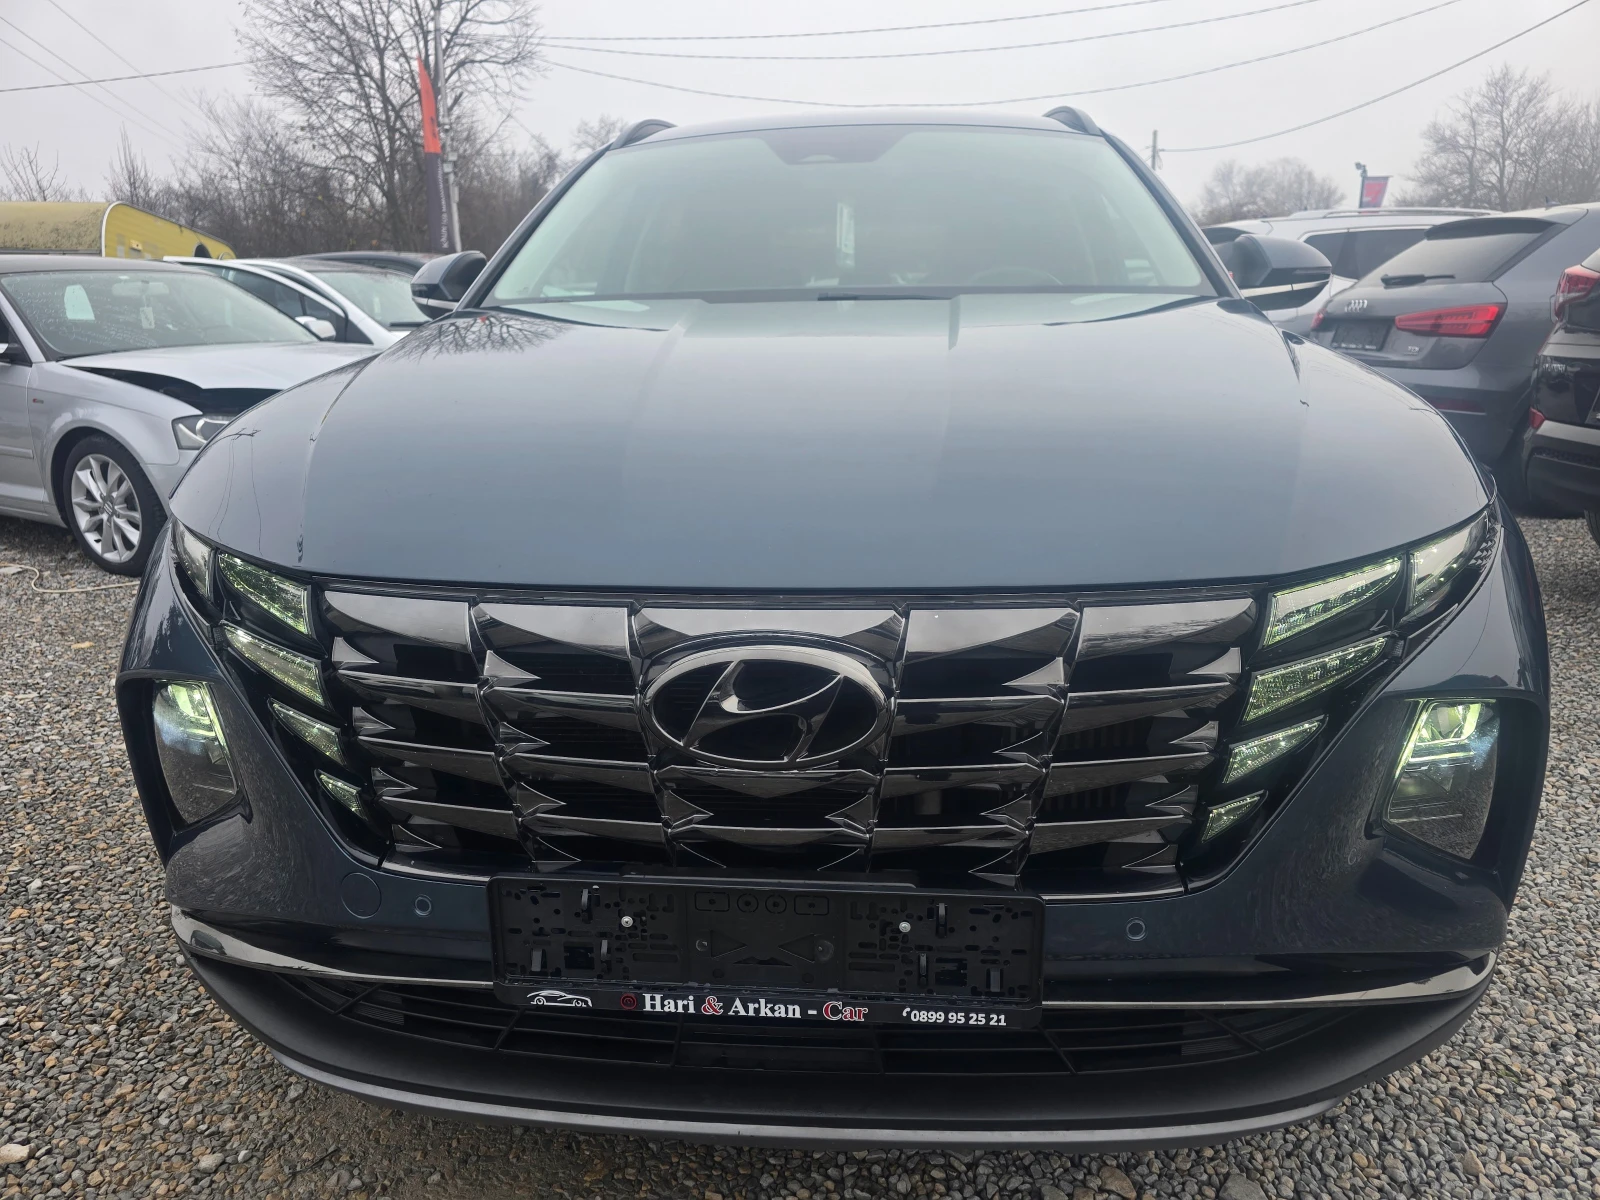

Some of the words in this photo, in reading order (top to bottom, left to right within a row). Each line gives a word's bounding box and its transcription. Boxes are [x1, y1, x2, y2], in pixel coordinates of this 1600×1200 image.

[642, 993, 696, 1014] Hari
[701, 995, 724, 1015] &
[728, 997, 801, 1019] Arkan
[822, 1001, 869, 1022] Car
[910, 1010, 945, 1023] 0899
[948, 1012, 966, 1024] 95
[968, 1013, 986, 1025] 25
[989, 1014, 1007, 1026] 21
